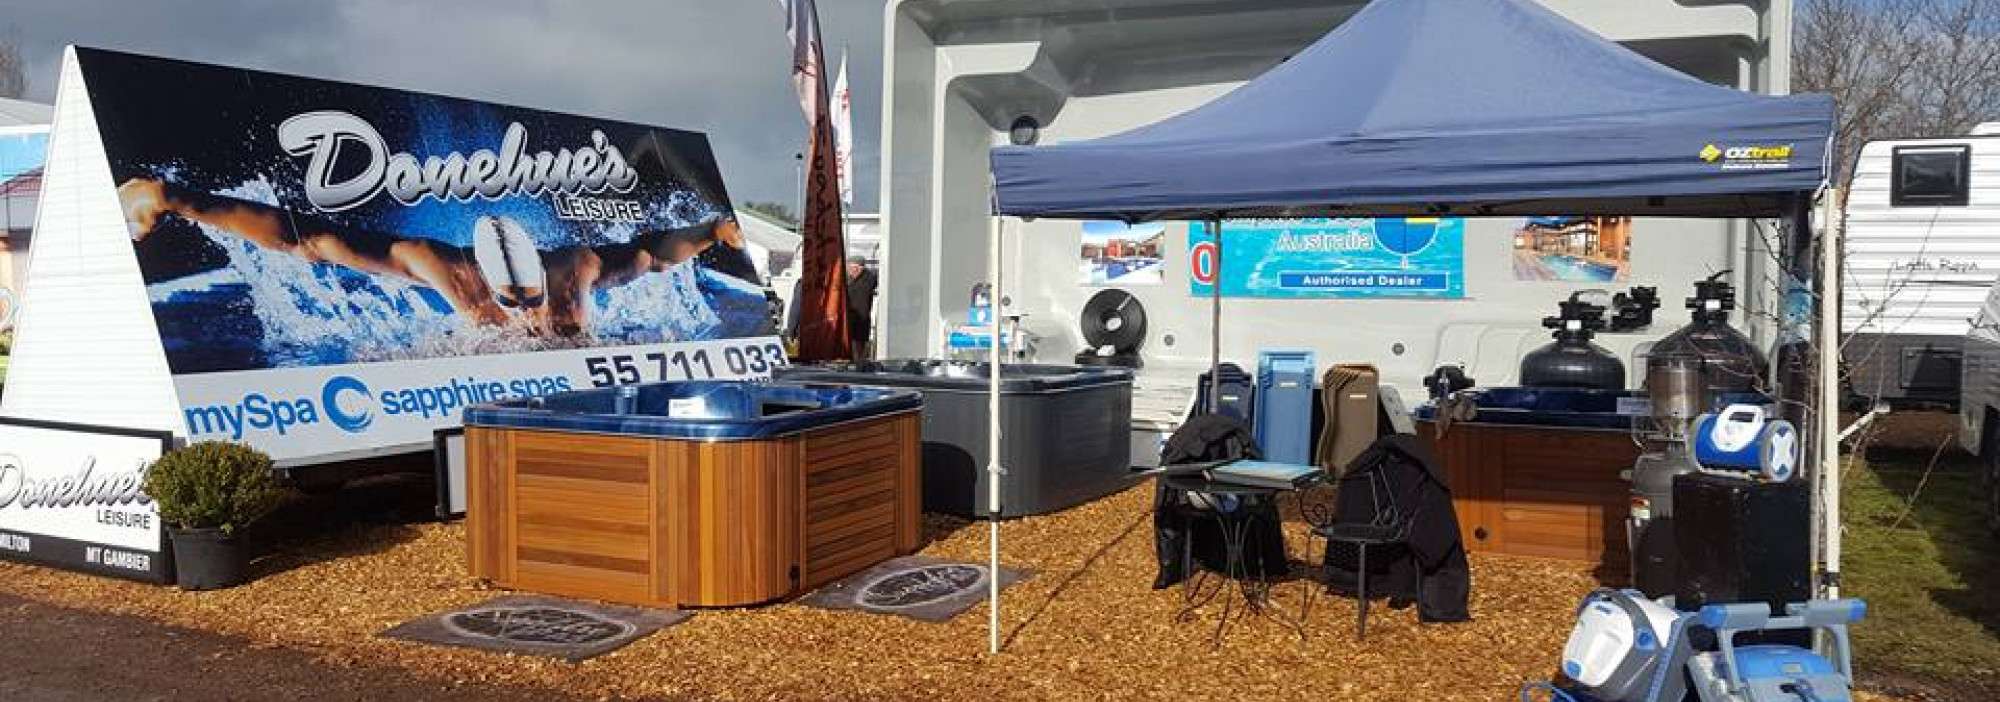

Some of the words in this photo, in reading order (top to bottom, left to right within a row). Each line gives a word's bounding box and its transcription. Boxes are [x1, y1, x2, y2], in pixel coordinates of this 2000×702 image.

[278, 110, 639, 213] Donehue's
[555, 199, 645, 221] LEISURE
[1277, 229, 1374, 251] Australia
[1303, 275, 1374, 286] Authorised
[1379, 275, 1422, 286] Dealer
[585, 354, 641, 388] 55
[645, 349, 714, 380] 711
[185, 393, 319, 440] mySpa
[380, 376, 506, 418] sapphire
[509, 373, 571, 399] spas
[97, 509, 151, 529] LEISURE
[86, 546, 101, 563] MT
[103, 549, 150, 571] GAMBIER
